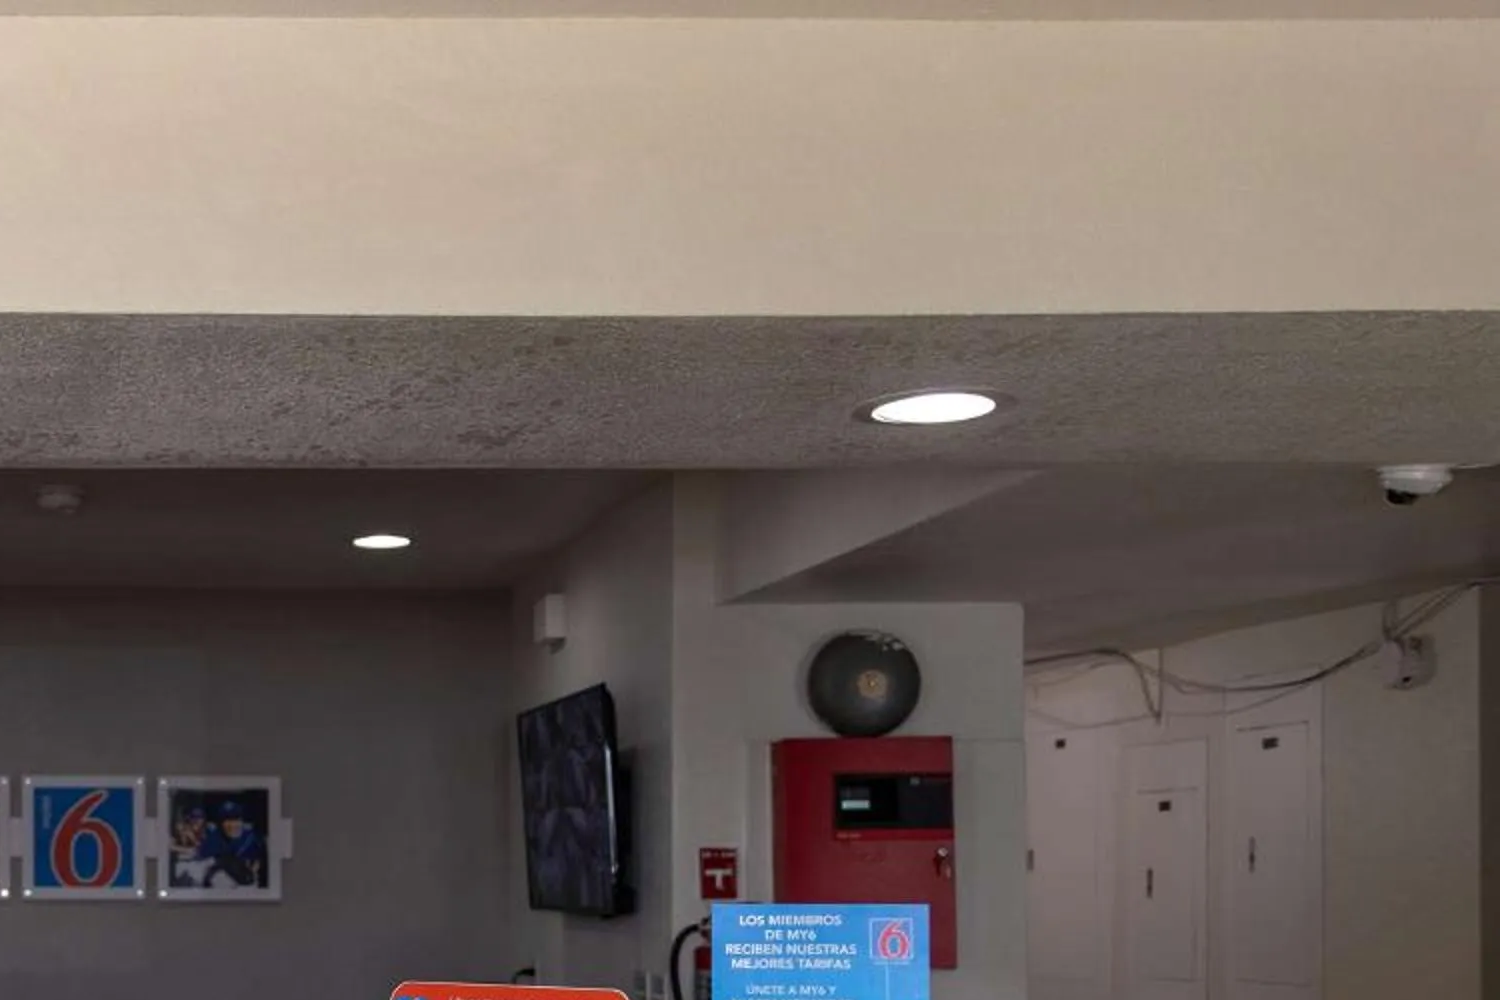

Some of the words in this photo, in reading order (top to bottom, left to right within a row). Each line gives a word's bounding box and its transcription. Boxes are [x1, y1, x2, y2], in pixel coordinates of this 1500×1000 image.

[50, 788, 122, 888] 6
[740, 914, 764, 926] LOS
[768, 914, 842, 926] MIEMBROS
[765, 929, 784, 941] DE
[787, 929, 817, 941] MY6
[877, 920, 910, 959] 6
[725, 943, 783, 955] RECIBEN
[786, 943, 857, 955] NUESTRAS
[731, 958, 794, 969] MEJORES
[800, 958, 851, 970] TARIFAS
